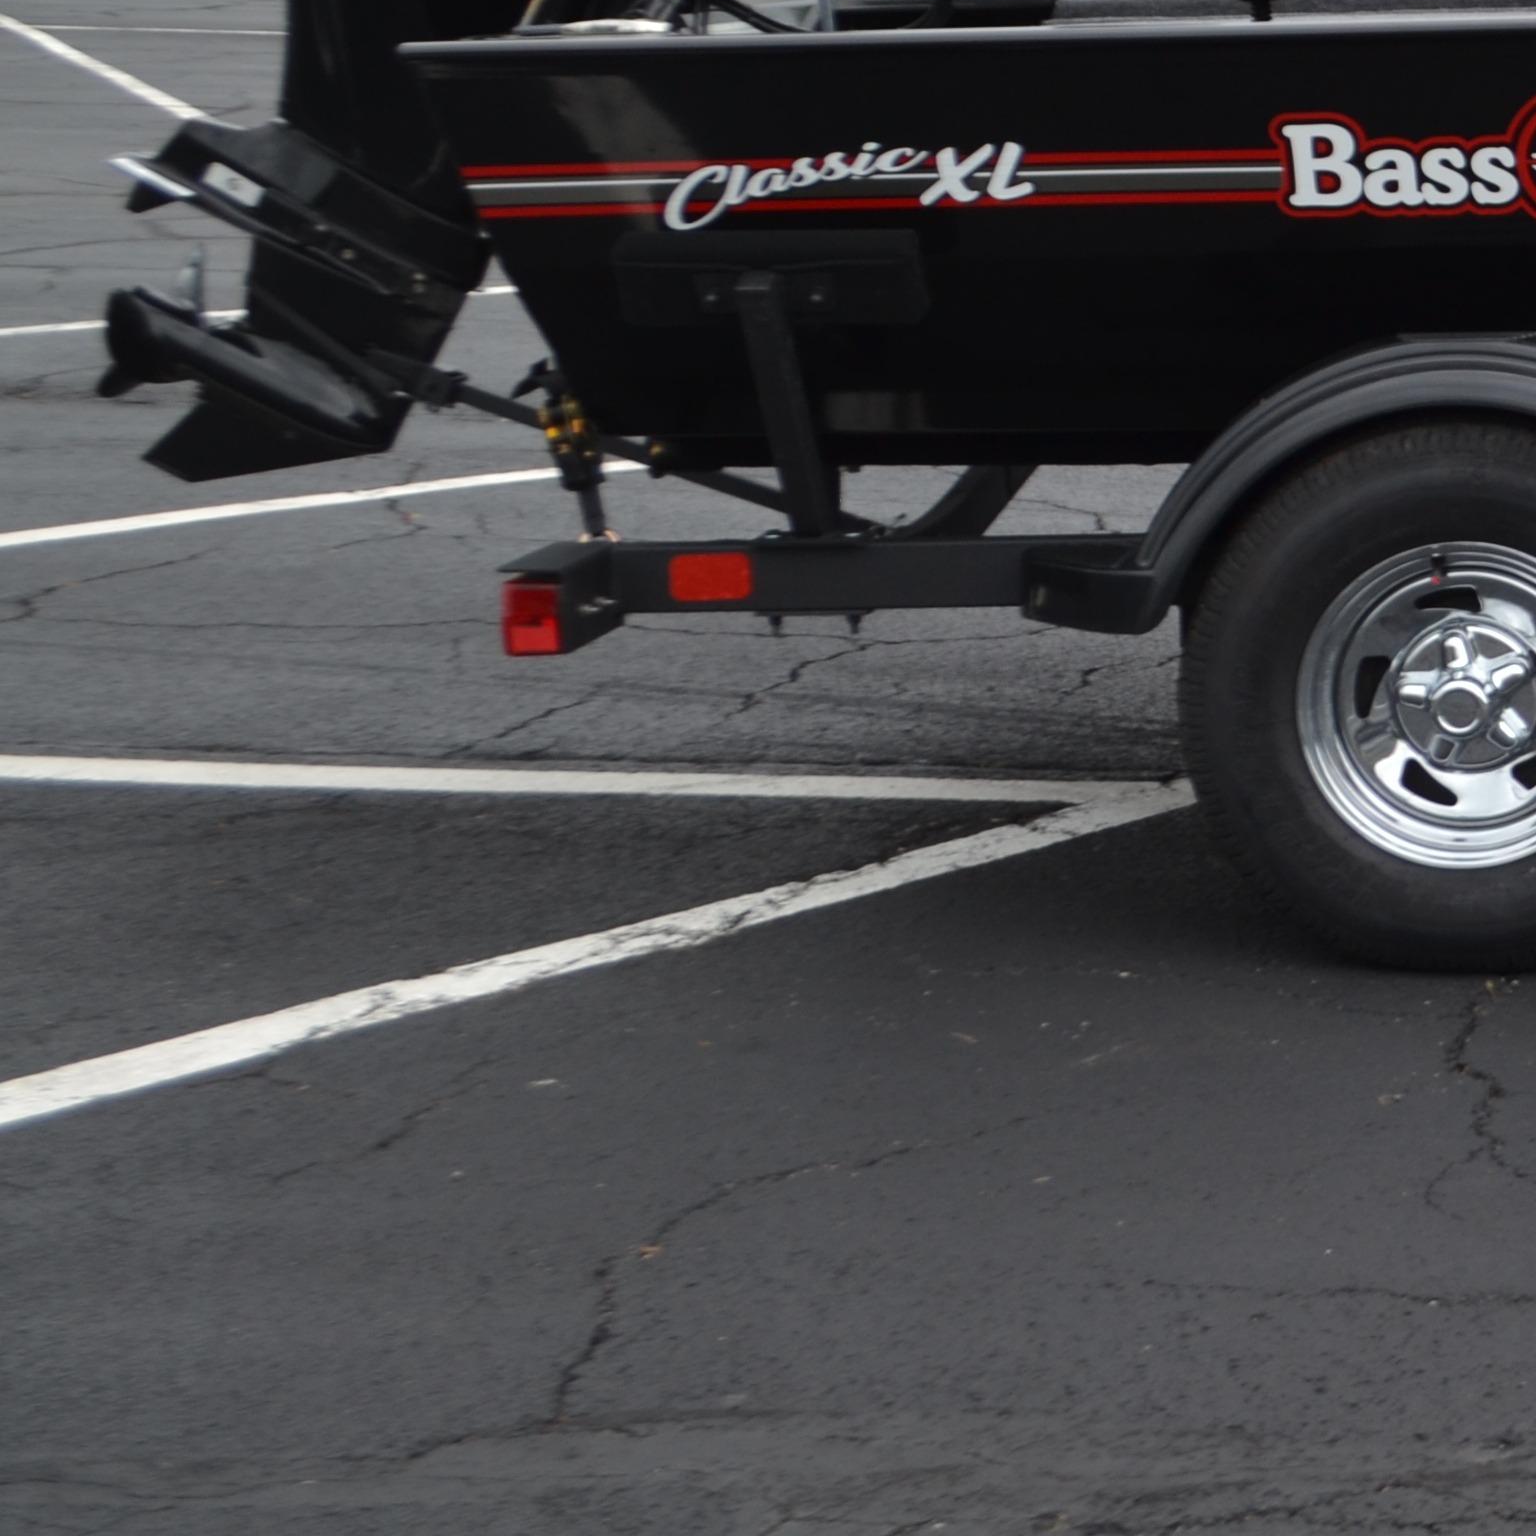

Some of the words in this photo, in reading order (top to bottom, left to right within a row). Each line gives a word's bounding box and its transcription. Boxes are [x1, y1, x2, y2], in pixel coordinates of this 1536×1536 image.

[664, 142, 929, 230] Classic
[919, 141, 1034, 206] XL
[1282, 122, 1519, 207] Bass
